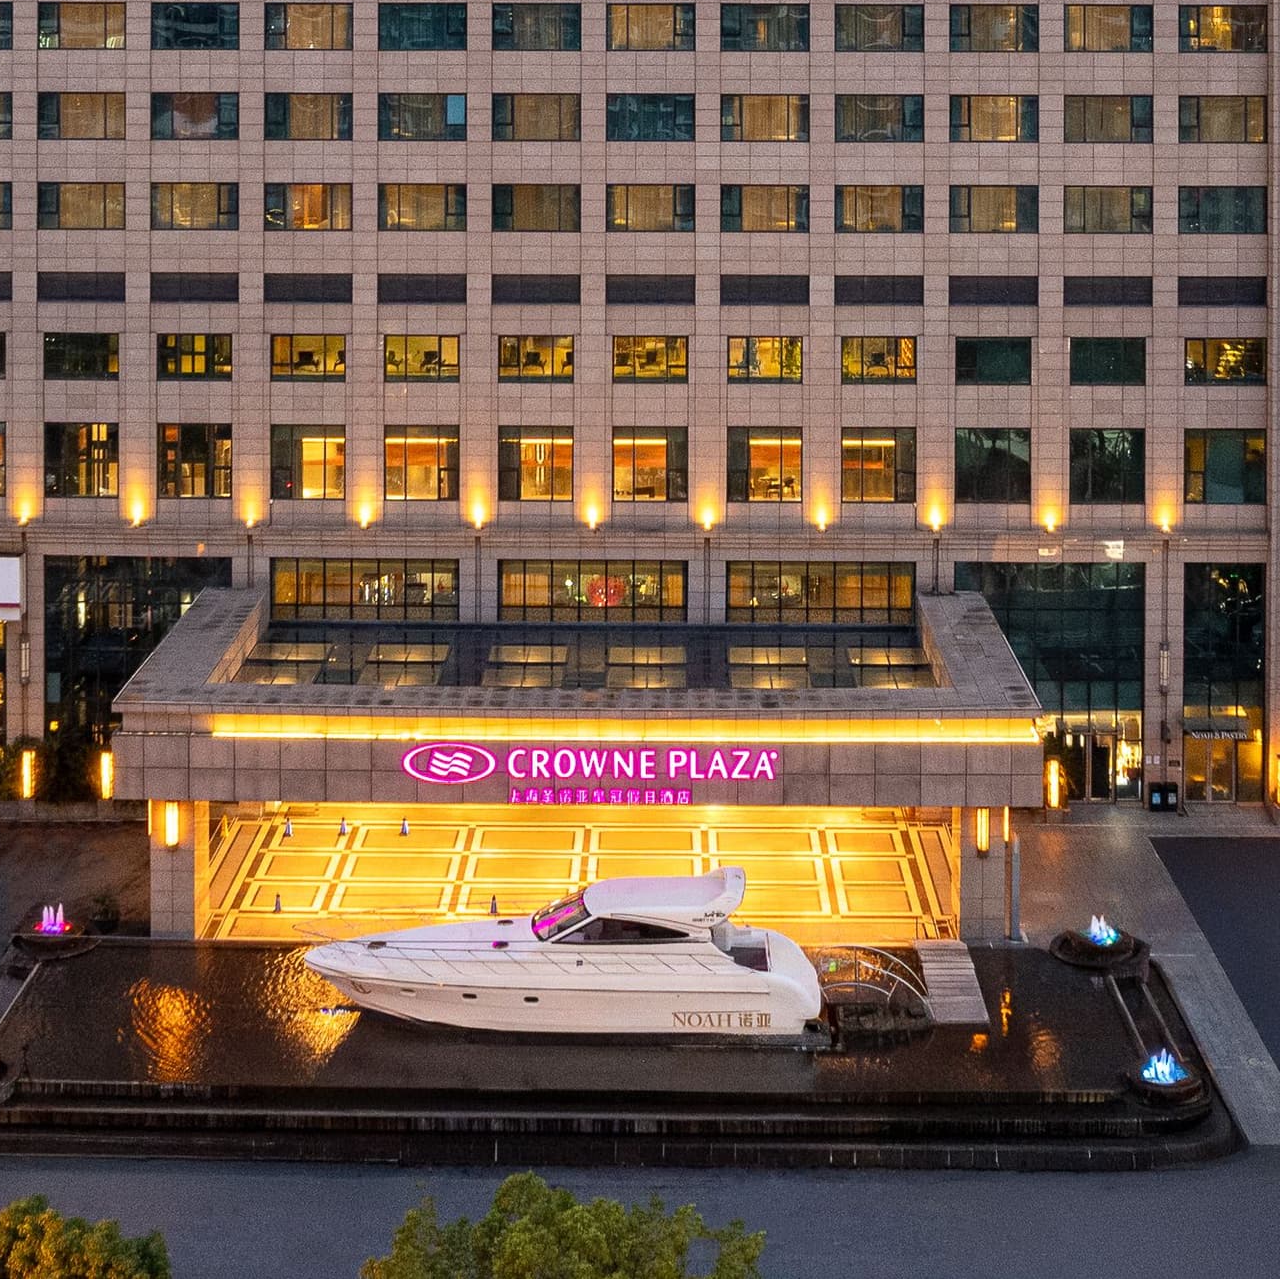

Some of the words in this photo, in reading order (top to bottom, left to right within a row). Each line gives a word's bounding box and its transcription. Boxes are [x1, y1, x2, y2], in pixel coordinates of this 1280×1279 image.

[507, 749, 657, 779] CROWNE
[672, 1013, 731, 1028] NOAH
[738, 1013, 771, 1028] 诺亚
